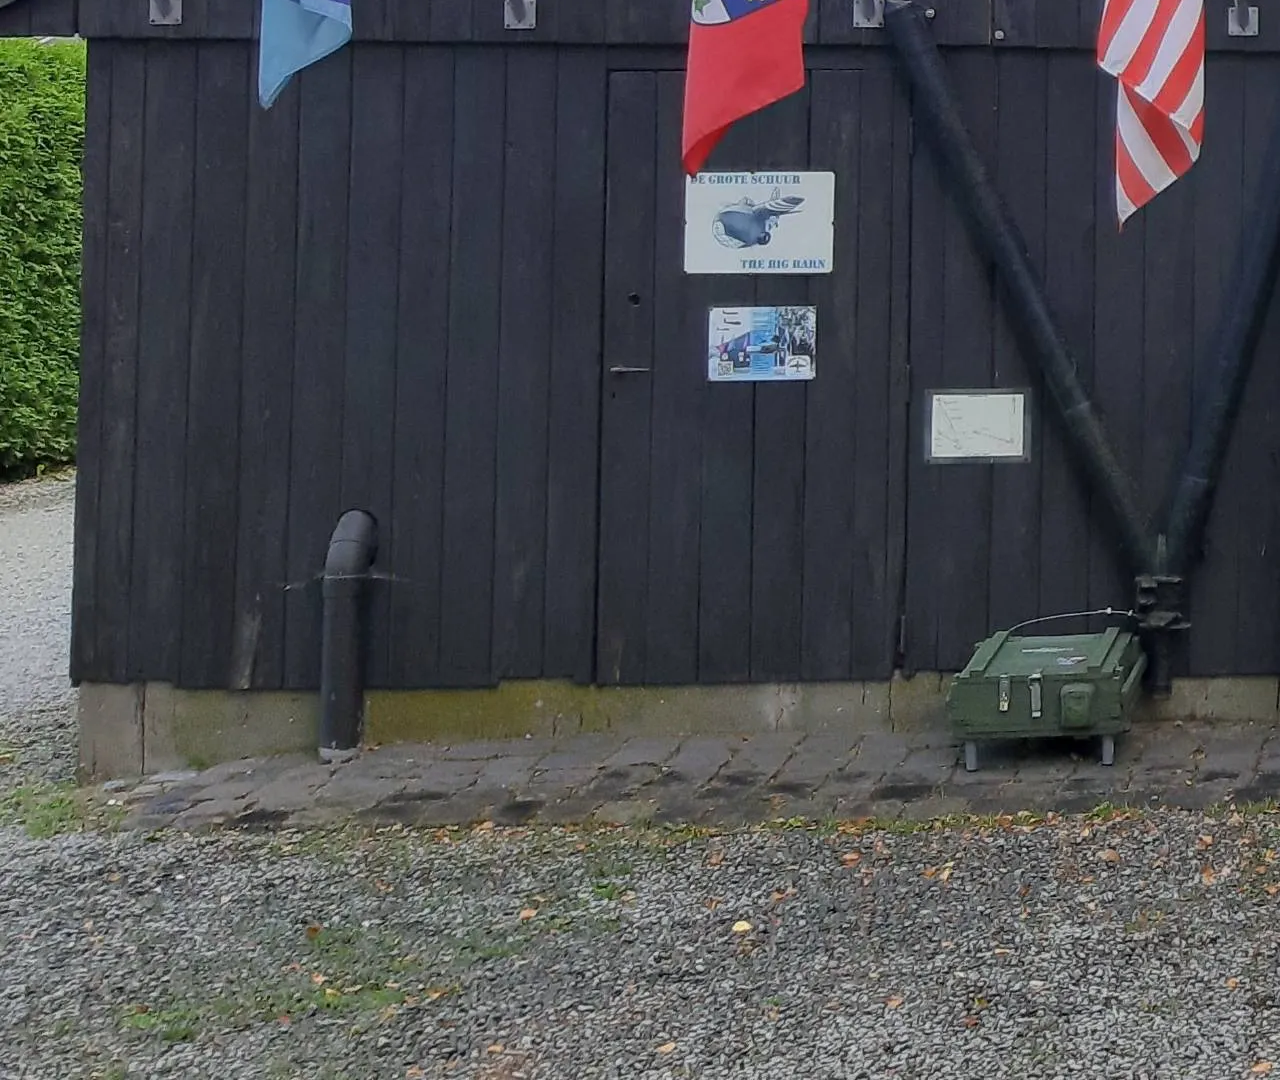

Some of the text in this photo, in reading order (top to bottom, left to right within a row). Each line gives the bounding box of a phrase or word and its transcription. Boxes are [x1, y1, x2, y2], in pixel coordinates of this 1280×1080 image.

[709, 175, 748, 184] GROTE
[751, 175, 801, 184] SCHUUR
[740, 259, 826, 269] THE BIG BARN
